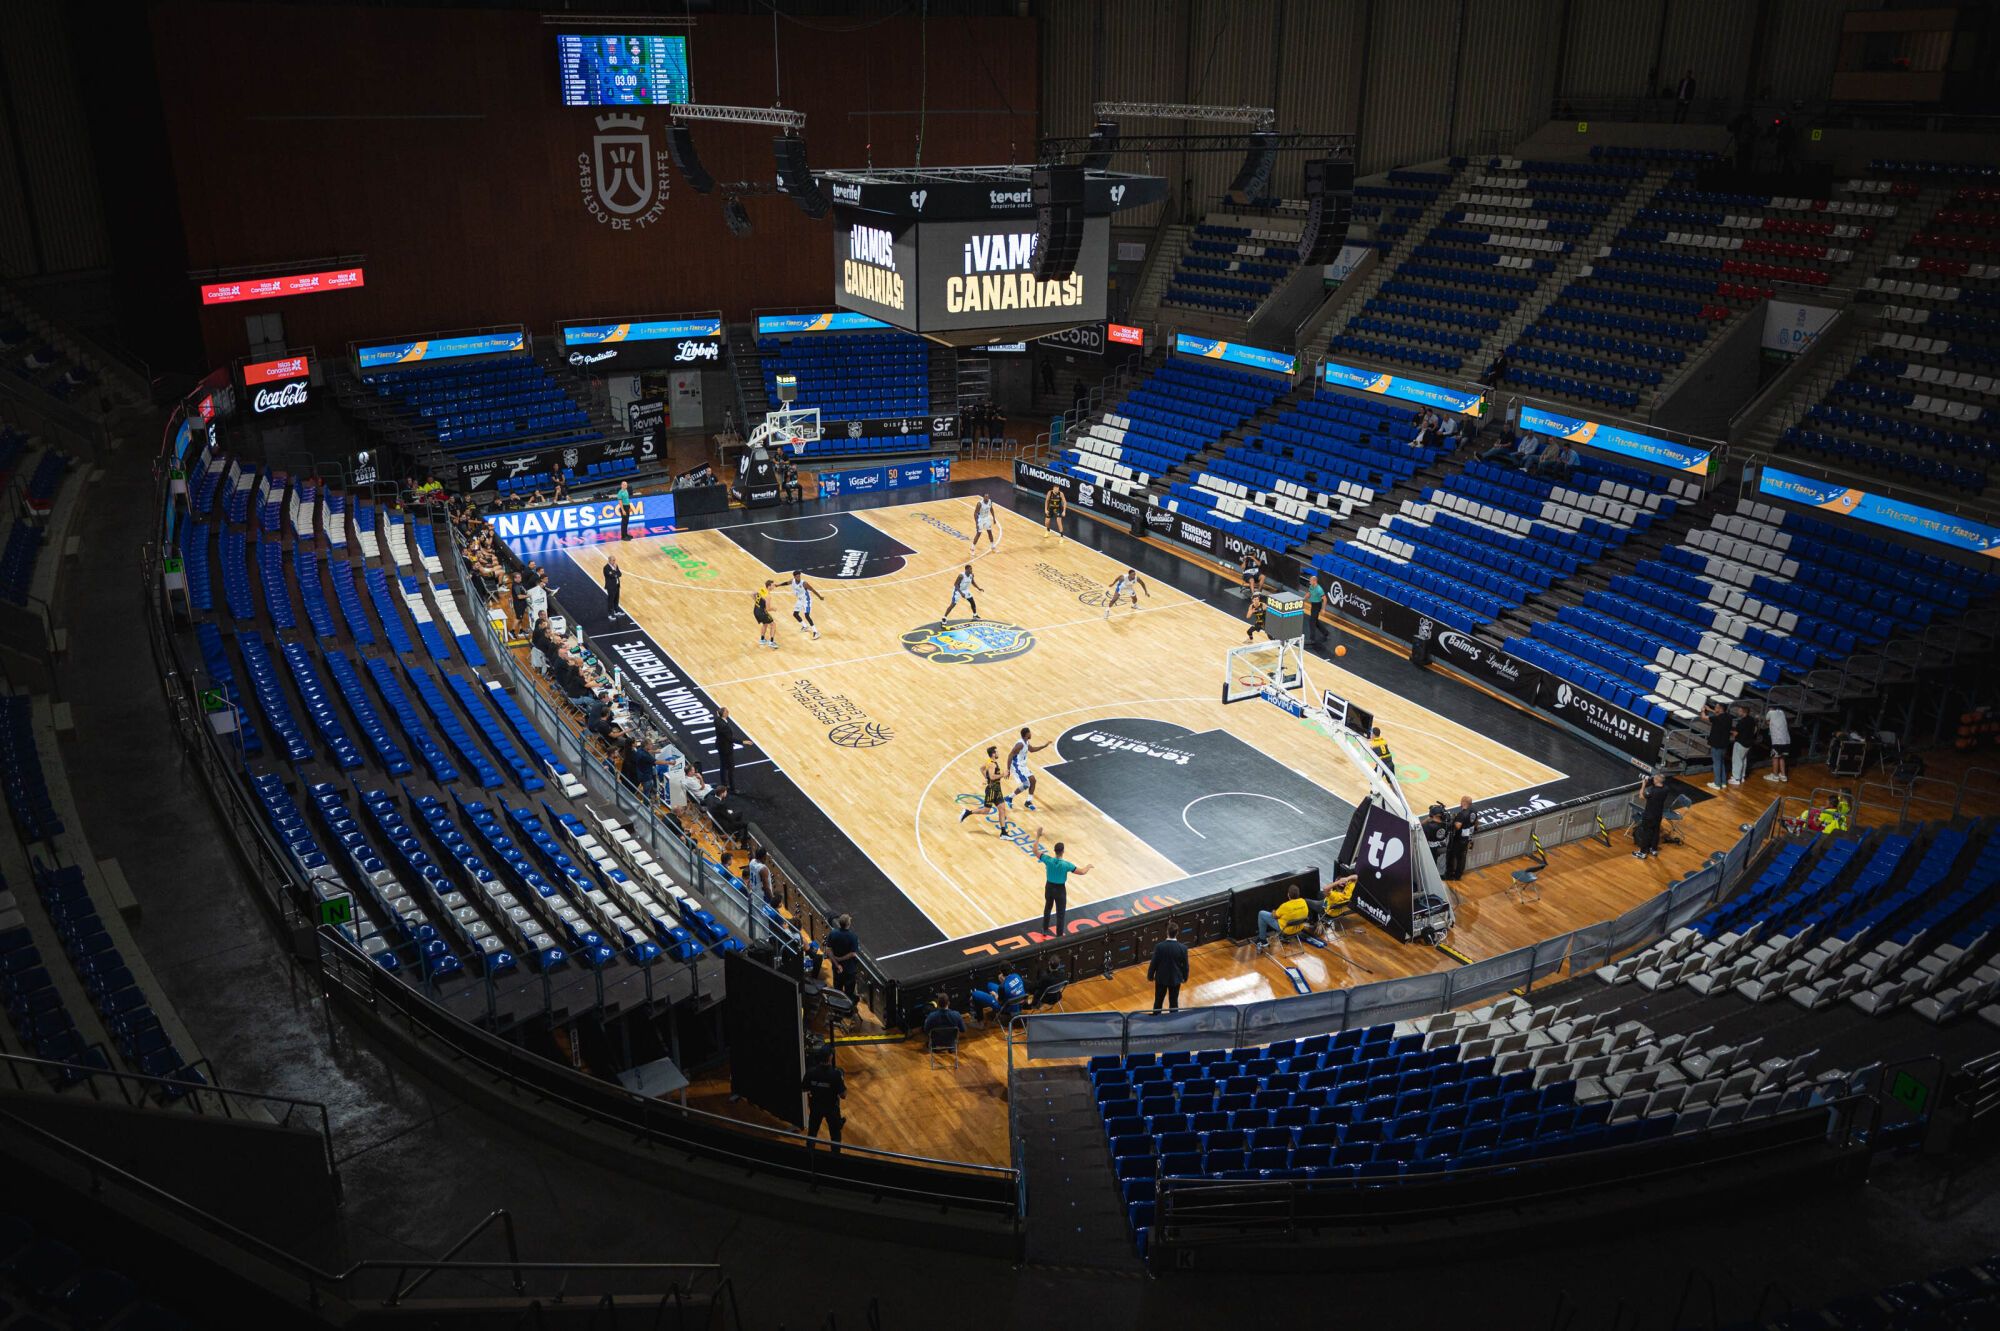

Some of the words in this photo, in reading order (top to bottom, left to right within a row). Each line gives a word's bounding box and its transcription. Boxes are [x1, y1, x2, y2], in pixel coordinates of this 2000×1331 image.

[578, 152, 609, 223] CABILDO
[611, 218, 631, 230] DE
[636, 151, 671, 229] TENERIFE
[990, 188, 1031, 203] teneri
[850, 224, 896, 272] ¡VAMOS,
[964, 233, 1039, 274] ¡VAM
[844, 259, 904, 310] CANARIAS!
[947, 271, 1083, 313] CANARIAS!
[674, 340, 718, 362] Libby's
[266, 367, 292, 375] Canarias
[933, 417, 954, 431] GF
[642, 436, 654, 453] 5
[462, 461, 498, 472] SPRING
[888, 468, 898, 479] 50
[1028, 467, 1071, 488] McDonald's
[1111, 497, 1140, 515] Hospiten
[1181, 521, 1212, 540] TERRENOS
[1284, 600, 1304, 611] 03:00
[1448, 635, 1482, 660] Balmes
[612, 640, 680, 689] TENERIFE
[656, 686, 717, 735] LAGUNA
[795, 679, 852, 723] CHAMPIONS
[1267, 694, 1294, 713] HOVIMA
[1072, 730, 1190, 765] tenerife!
[1357, 896, 1392, 926] tenerife!
